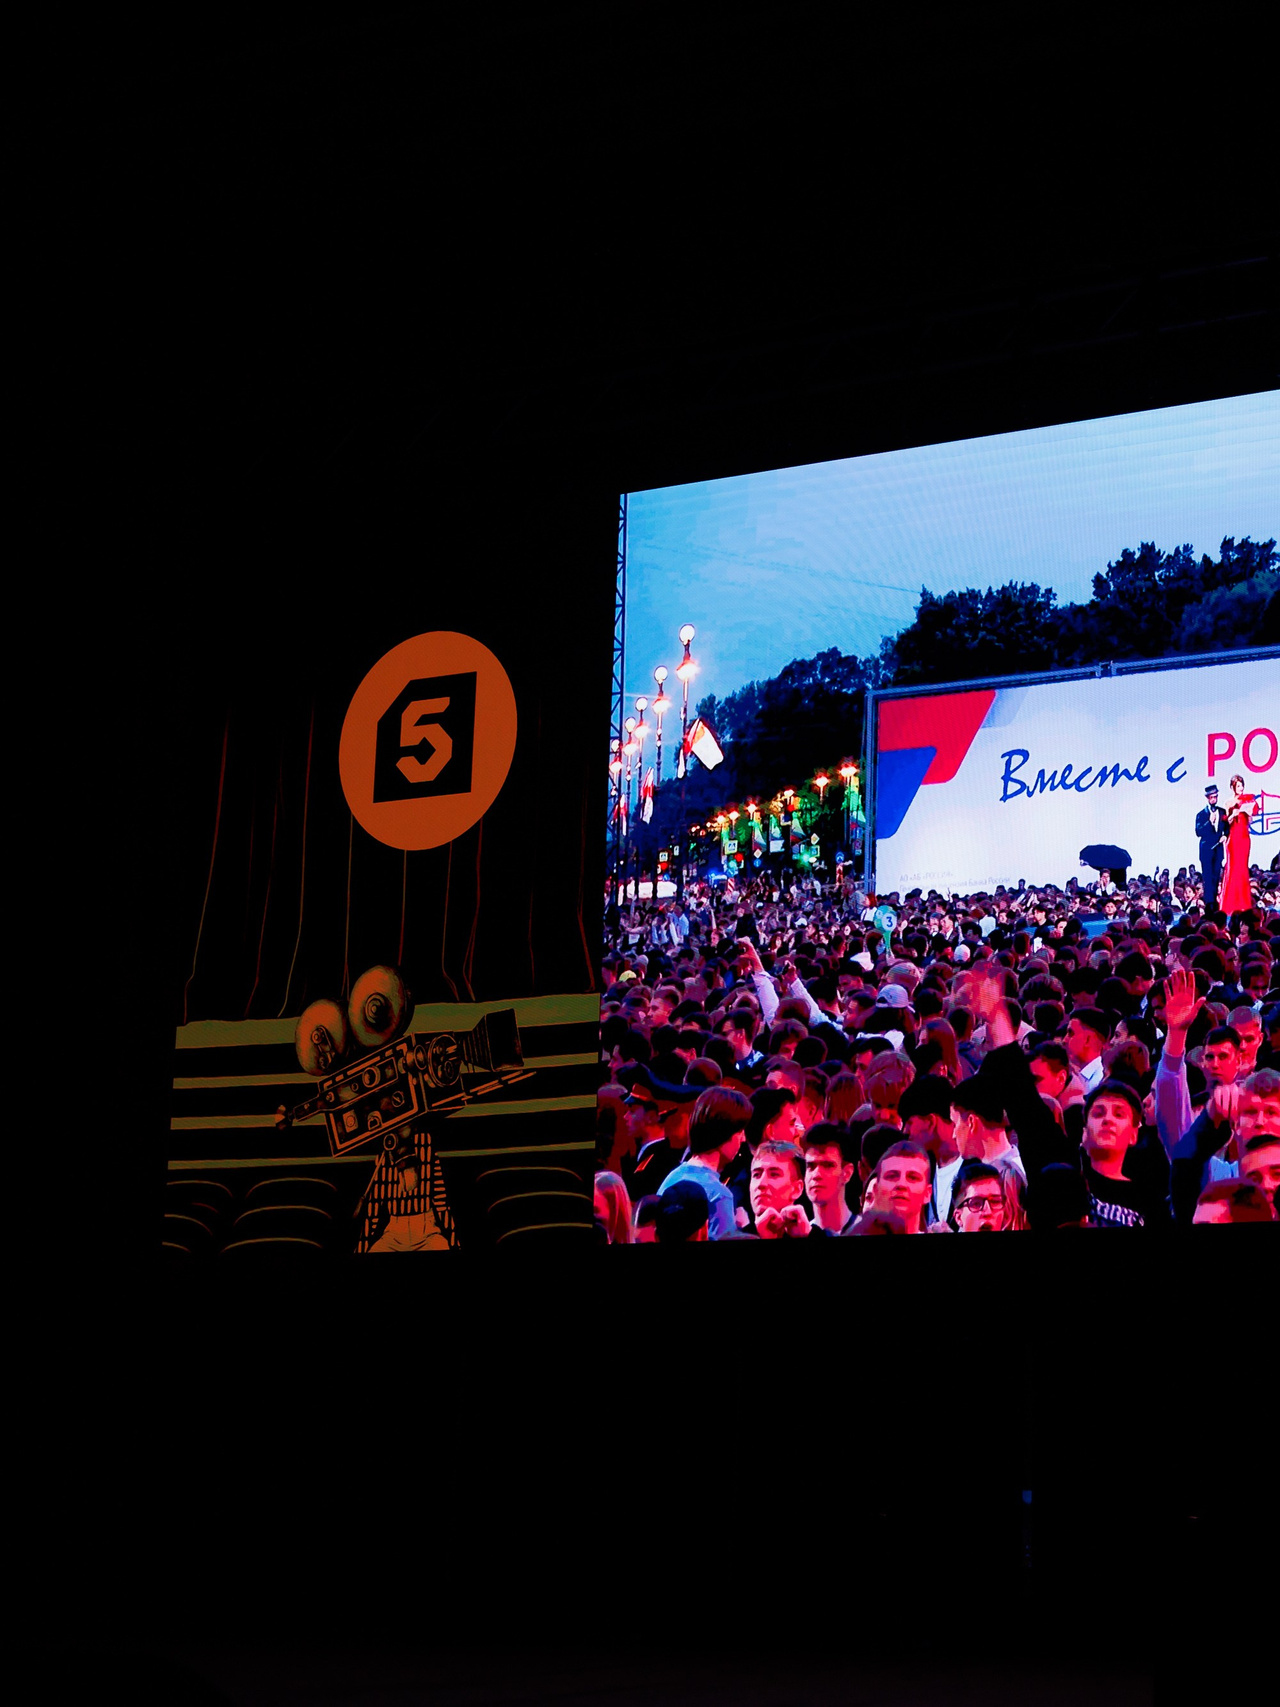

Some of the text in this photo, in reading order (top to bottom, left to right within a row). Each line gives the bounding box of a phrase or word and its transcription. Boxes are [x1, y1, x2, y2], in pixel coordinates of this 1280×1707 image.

[395, 696, 453, 783] 5
[999, 748, 1151, 802] Вместе
[1166, 756, 1187, 783] с
[886, 916, 893, 928] 3
